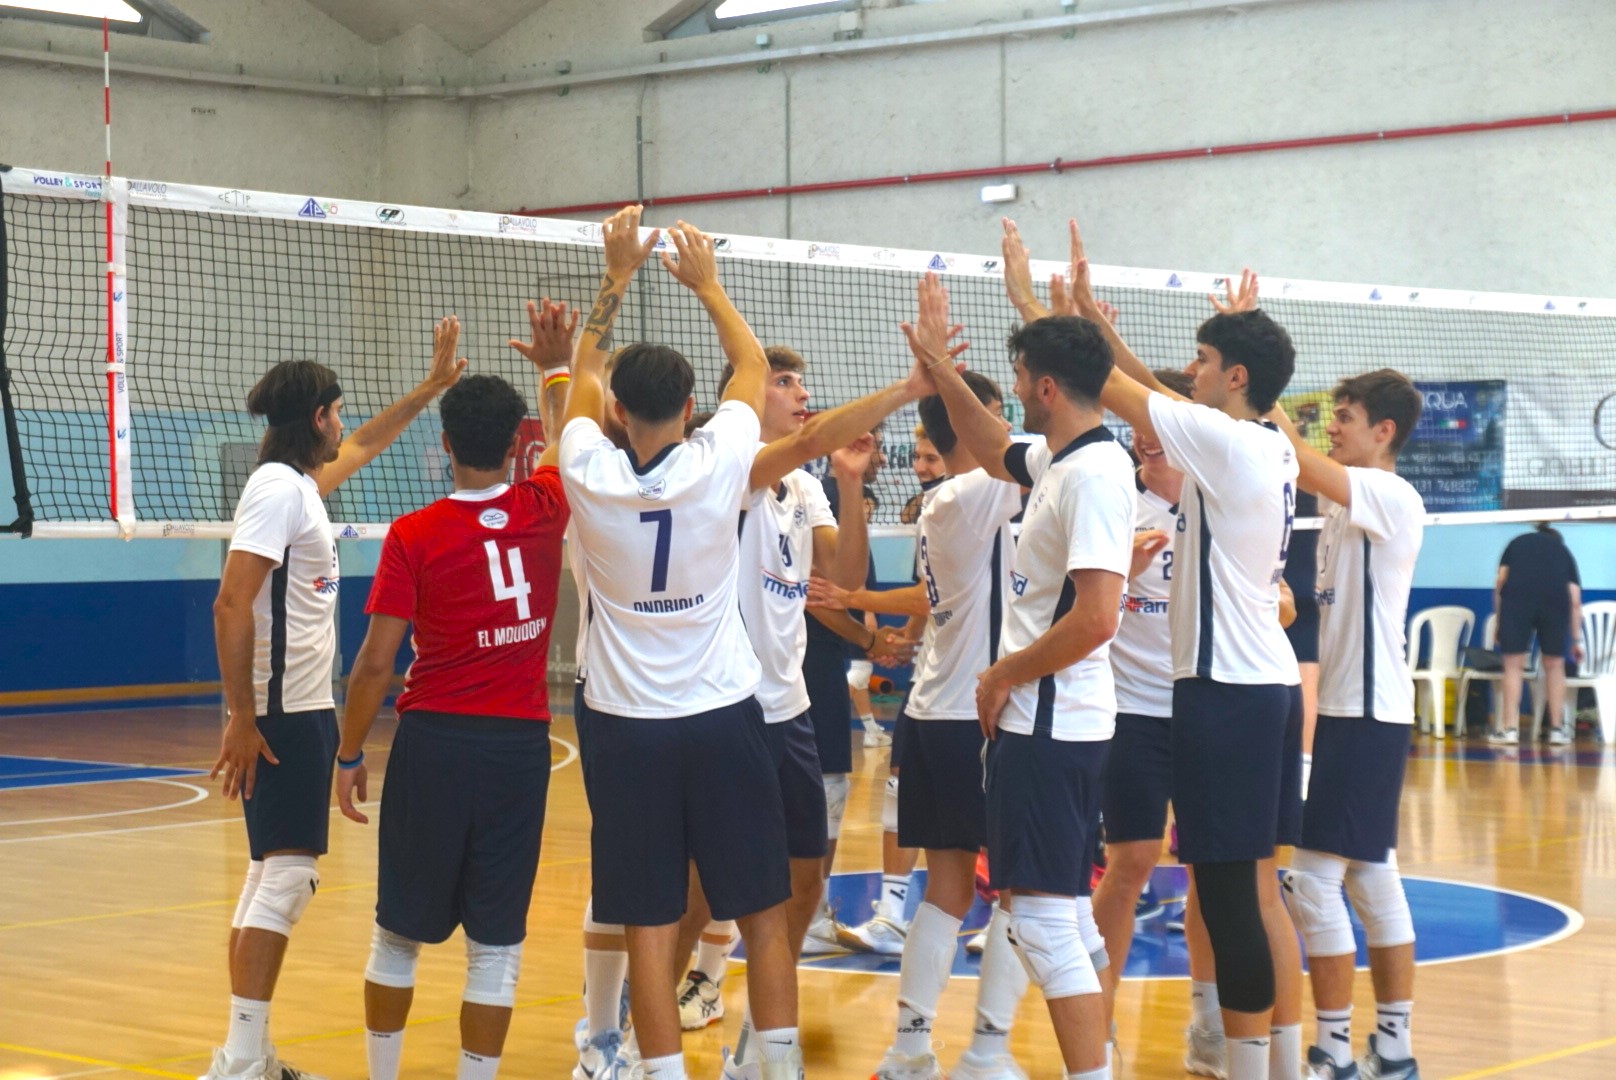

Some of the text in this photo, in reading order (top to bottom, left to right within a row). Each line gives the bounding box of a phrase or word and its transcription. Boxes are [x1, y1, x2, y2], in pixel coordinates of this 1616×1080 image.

[33, 175, 63, 187] VOLLEY
[73, 180, 102, 190] SPORT
[639, 508, 673, 593] 7
[483, 539, 532, 621] 4
[477, 630, 492, 649] EL
